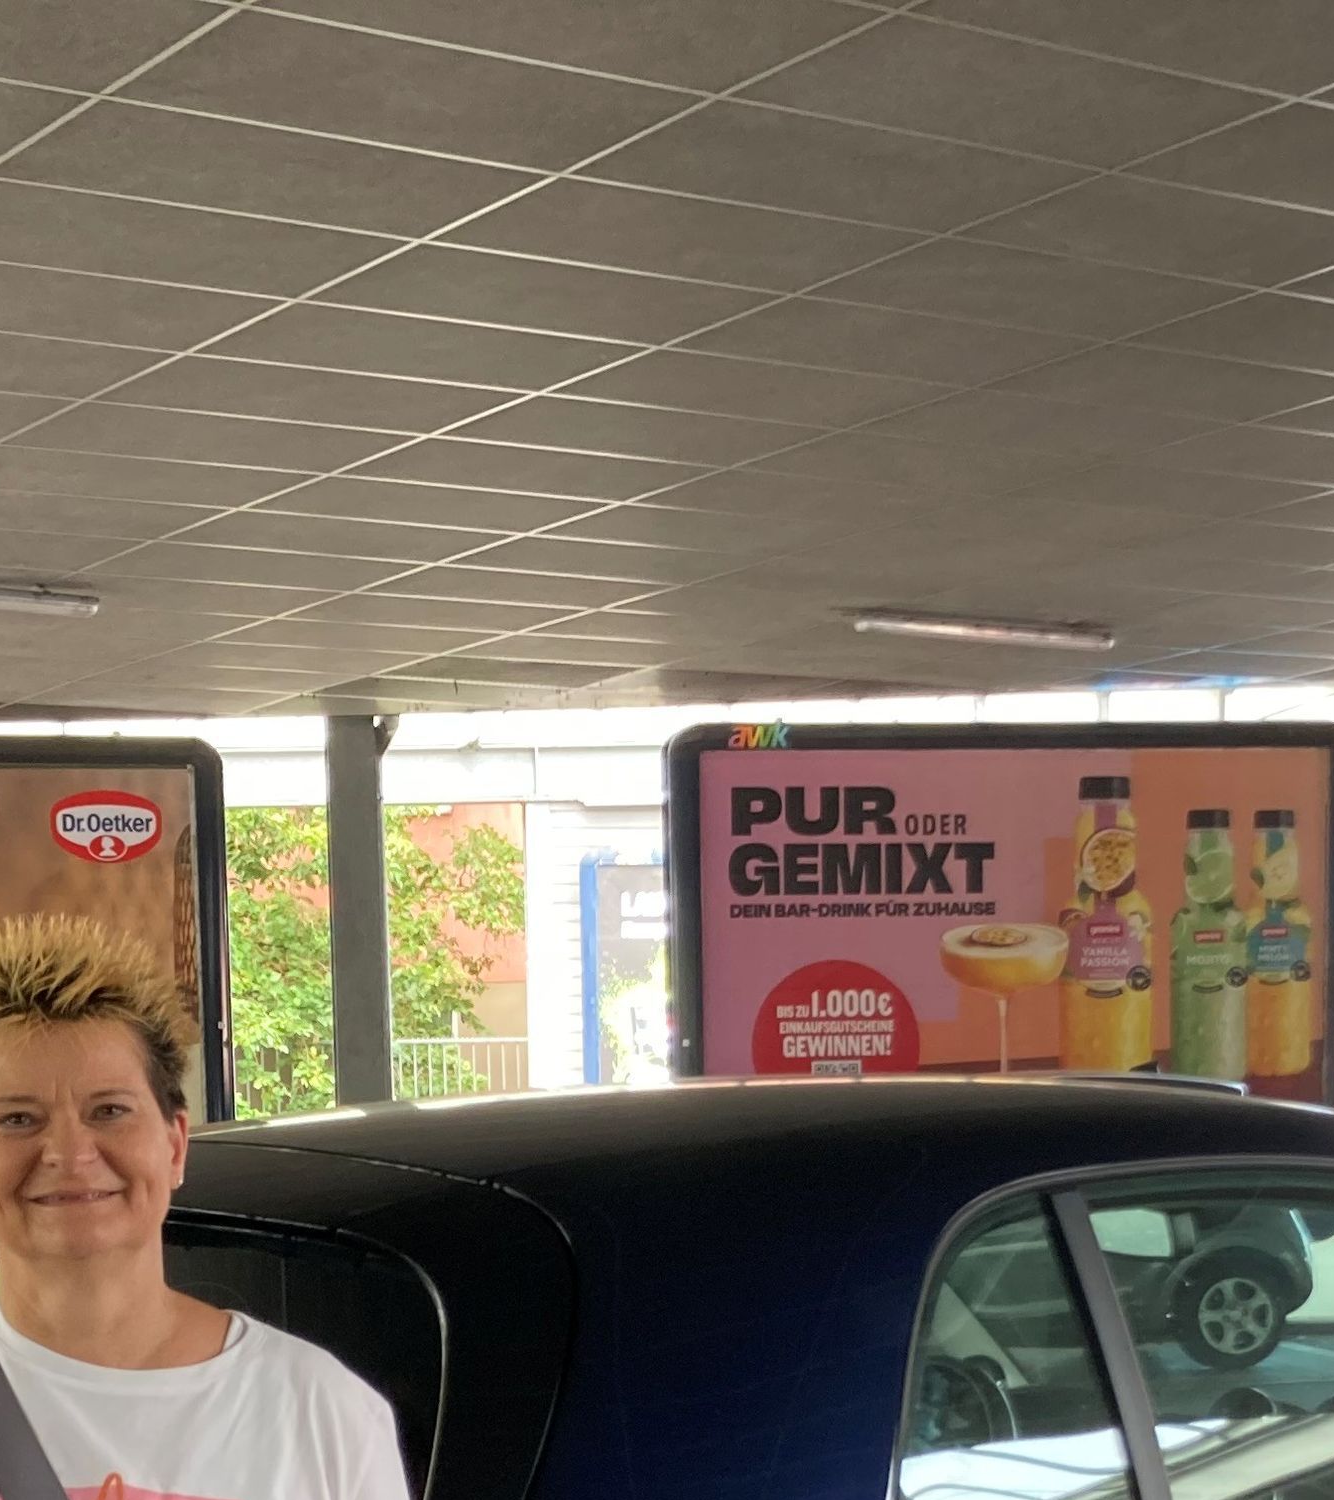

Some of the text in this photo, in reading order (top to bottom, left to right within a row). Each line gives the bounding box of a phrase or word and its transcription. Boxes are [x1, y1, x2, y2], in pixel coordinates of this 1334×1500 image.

[729, 719, 790, 749] awk
[730, 786, 967, 836] PUR ODER
[728, 841, 996, 897] GEMIXT
[730, 900, 996, 919] DEIN BAR-DRINK FÜR ZUHAUSE
[776, 1005, 795, 1018] BIS
[795, 1005, 810, 1018] ZU
[778, 1019, 895, 1034] EINKAUFSGUTSCHEINE
[782, 1034, 893, 1058] GEWINNEN!
